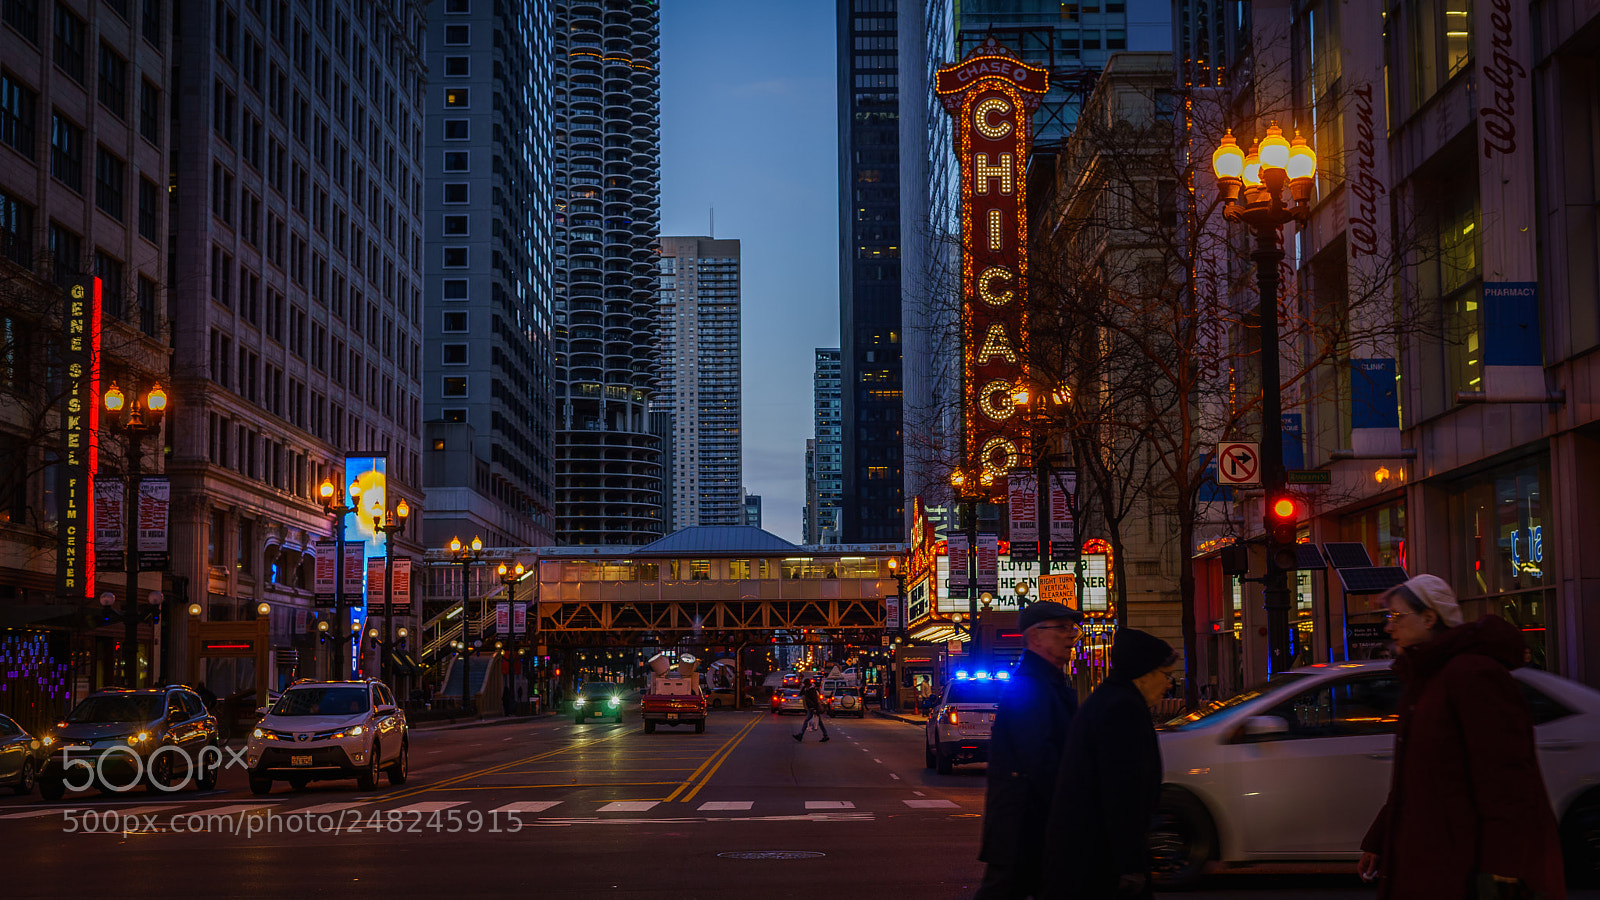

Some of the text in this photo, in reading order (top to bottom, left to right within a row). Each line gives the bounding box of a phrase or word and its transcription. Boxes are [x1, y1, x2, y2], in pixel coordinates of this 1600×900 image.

[957, 62, 1011, 82] CHASE
[1350, 84, 1385, 258] Walgreens
[974, 97, 1018, 477] CHICAGO
[1484, 288, 1535, 297] PHARMACY
[71, 284, 85, 351] GENE
[66, 478, 77, 519] FILM
[1011, 490, 1024, 520] WOMAN
[1024, 493, 1035, 521] PRETTY
[96, 498, 108, 529] WOMAN
[140, 497, 153, 529] WOMAN
[153, 501, 166, 529] PRETTY
[65, 526, 77, 588] CENTER
[949, 547, 959, 569] WOMAN
[997, 561, 1032, 571] LOYD
[1050, 561, 1068, 571] AR
[997, 578, 1016, 588] HE
[1041, 591, 1073, 599] CLEARANCE
[1044, 583, 1070, 591] VERTICAL
